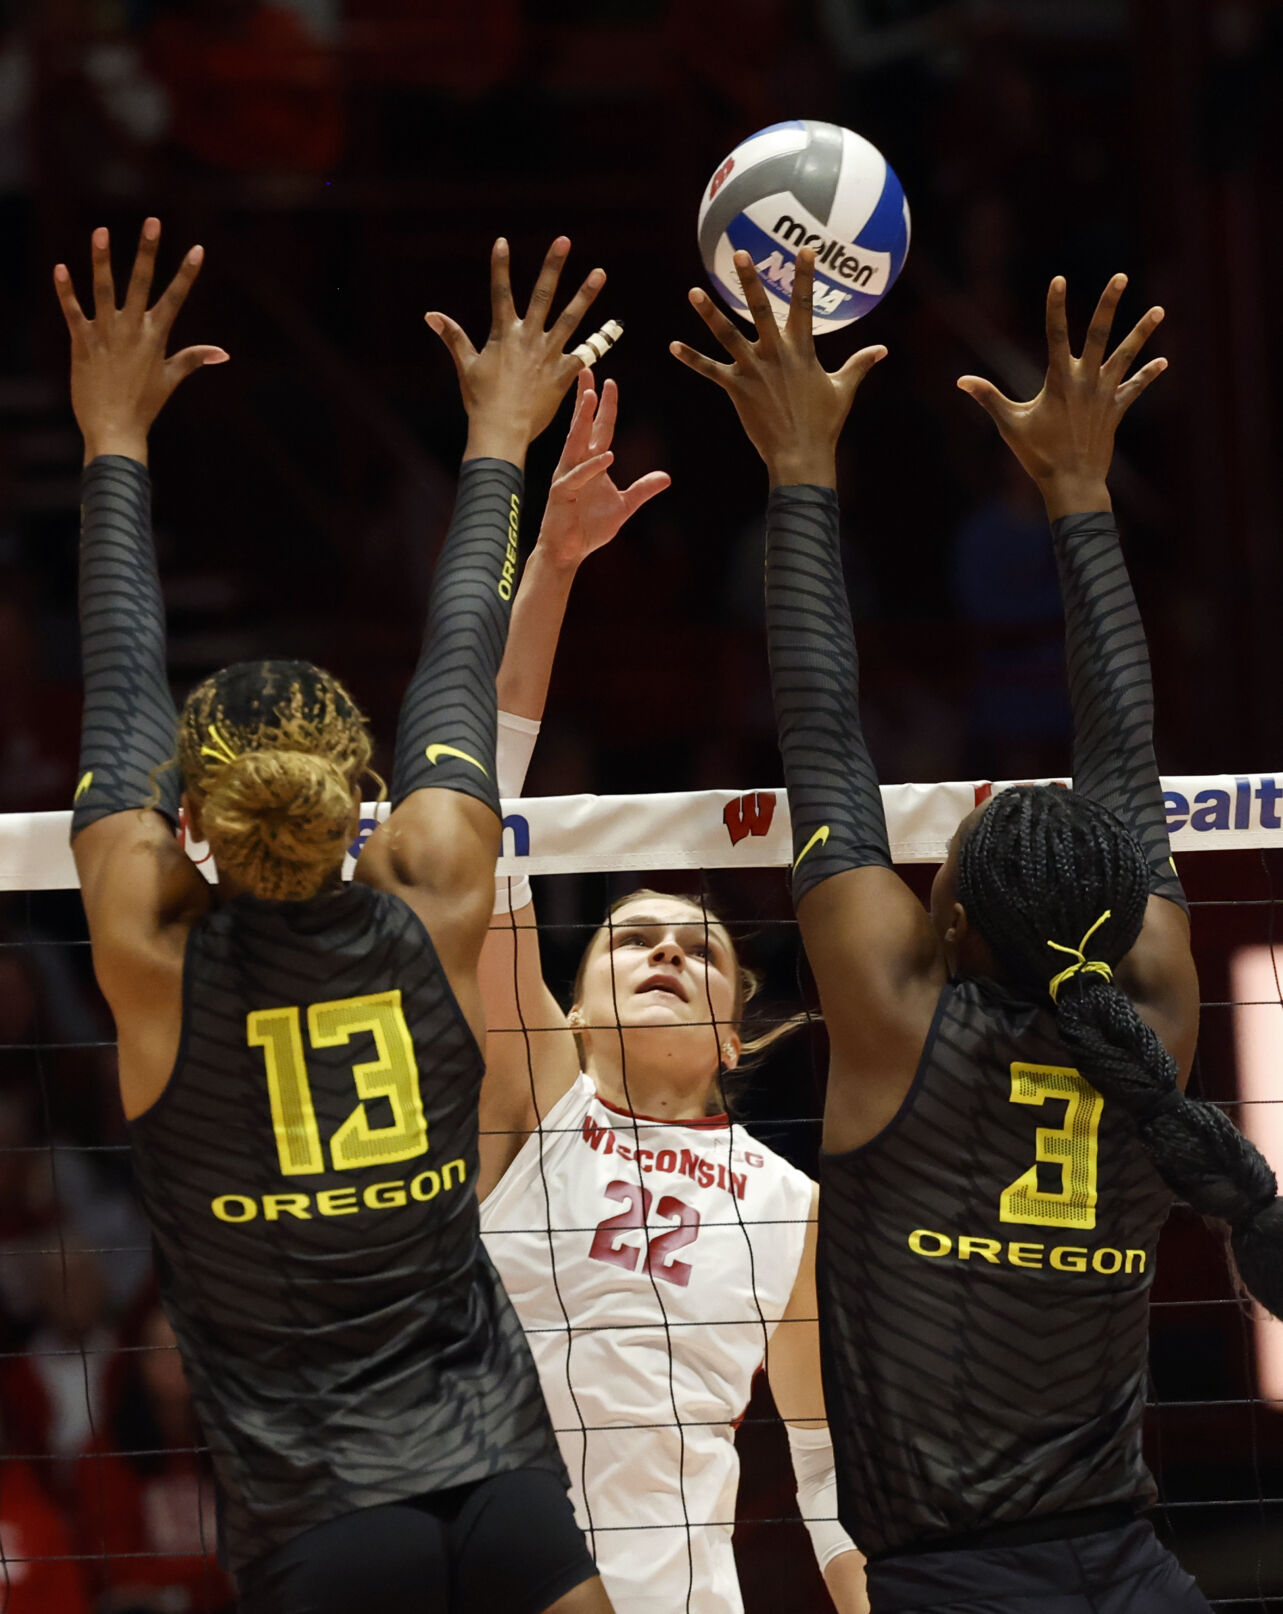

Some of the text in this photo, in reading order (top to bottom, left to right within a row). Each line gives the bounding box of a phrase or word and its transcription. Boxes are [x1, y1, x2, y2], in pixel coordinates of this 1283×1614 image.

[772, 214, 874, 287] molten
[498, 493, 520, 601] OREGON
[722, 791, 777, 847] W
[246, 988, 429, 1176] 13
[582, 1115, 748, 1200] WISCONSIN
[1000, 1061, 1105, 1230] 3
[211, 1158, 467, 1223] OREGON
[588, 1179, 701, 1288] 22
[907, 1229, 1147, 1275] OREGON
